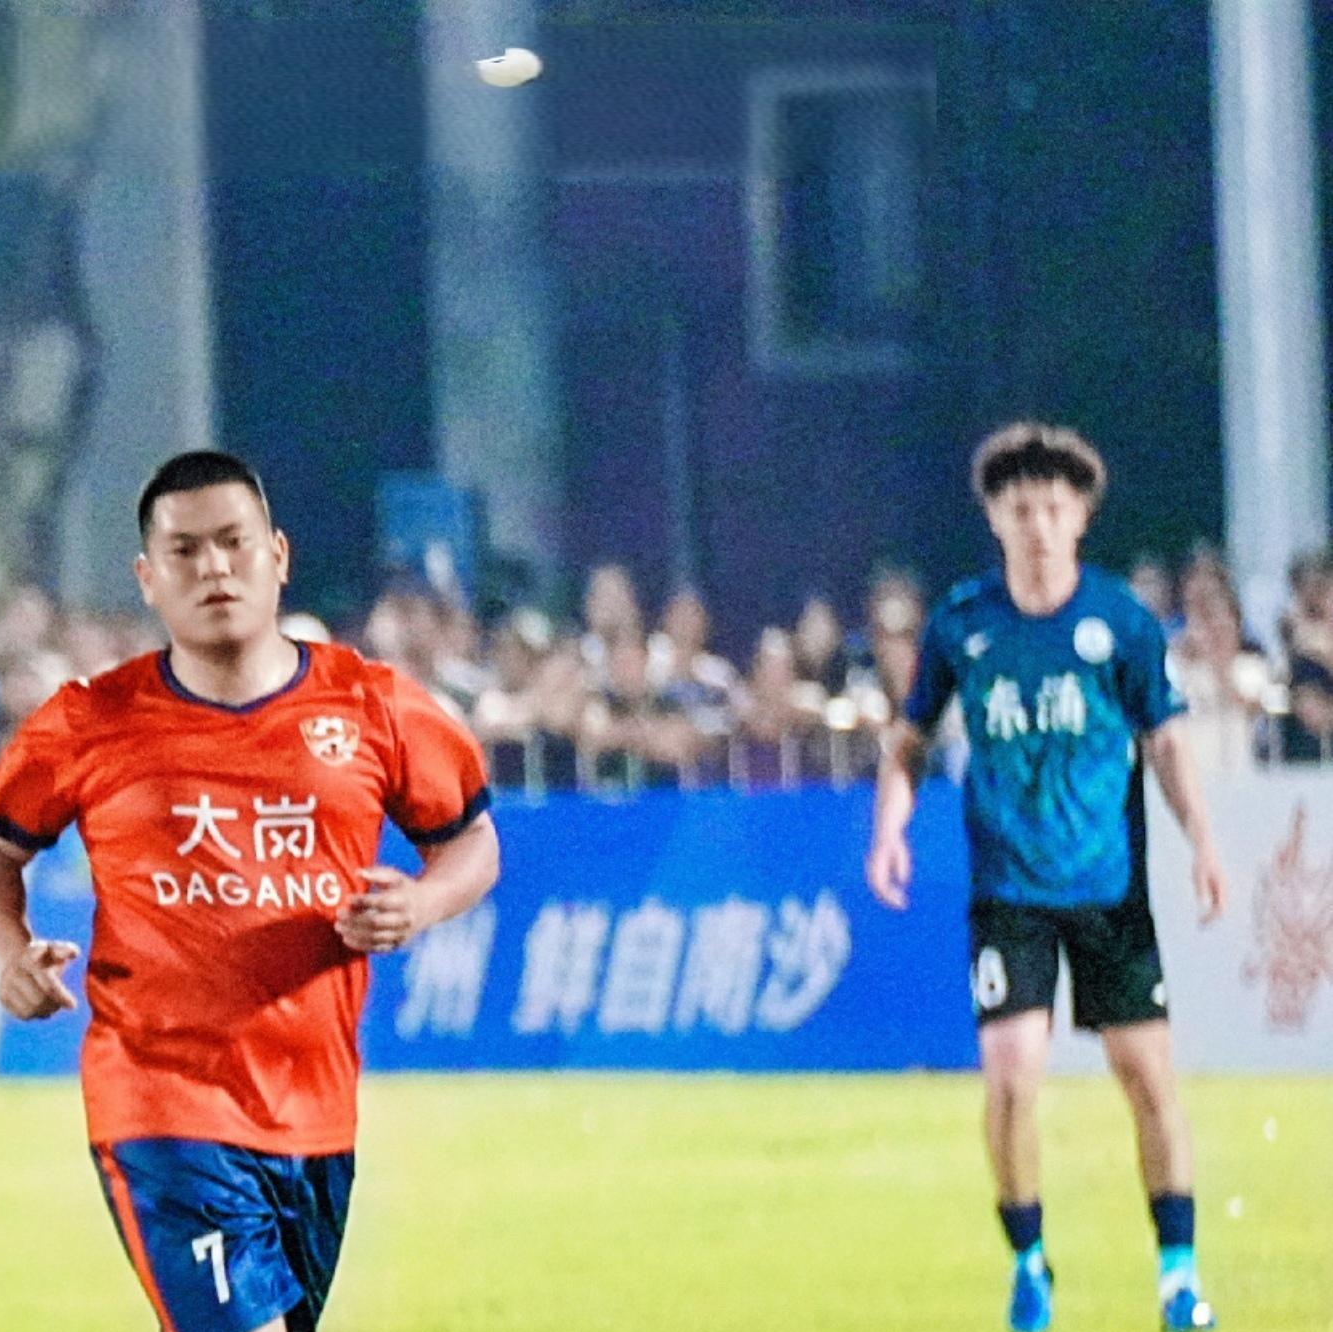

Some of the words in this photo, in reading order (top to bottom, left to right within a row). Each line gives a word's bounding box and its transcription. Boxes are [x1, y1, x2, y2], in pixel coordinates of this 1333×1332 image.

[171, 794, 316, 863] 大岗
[152, 872, 342, 908] DAGANG
[191, 1229, 230, 1304] 7
